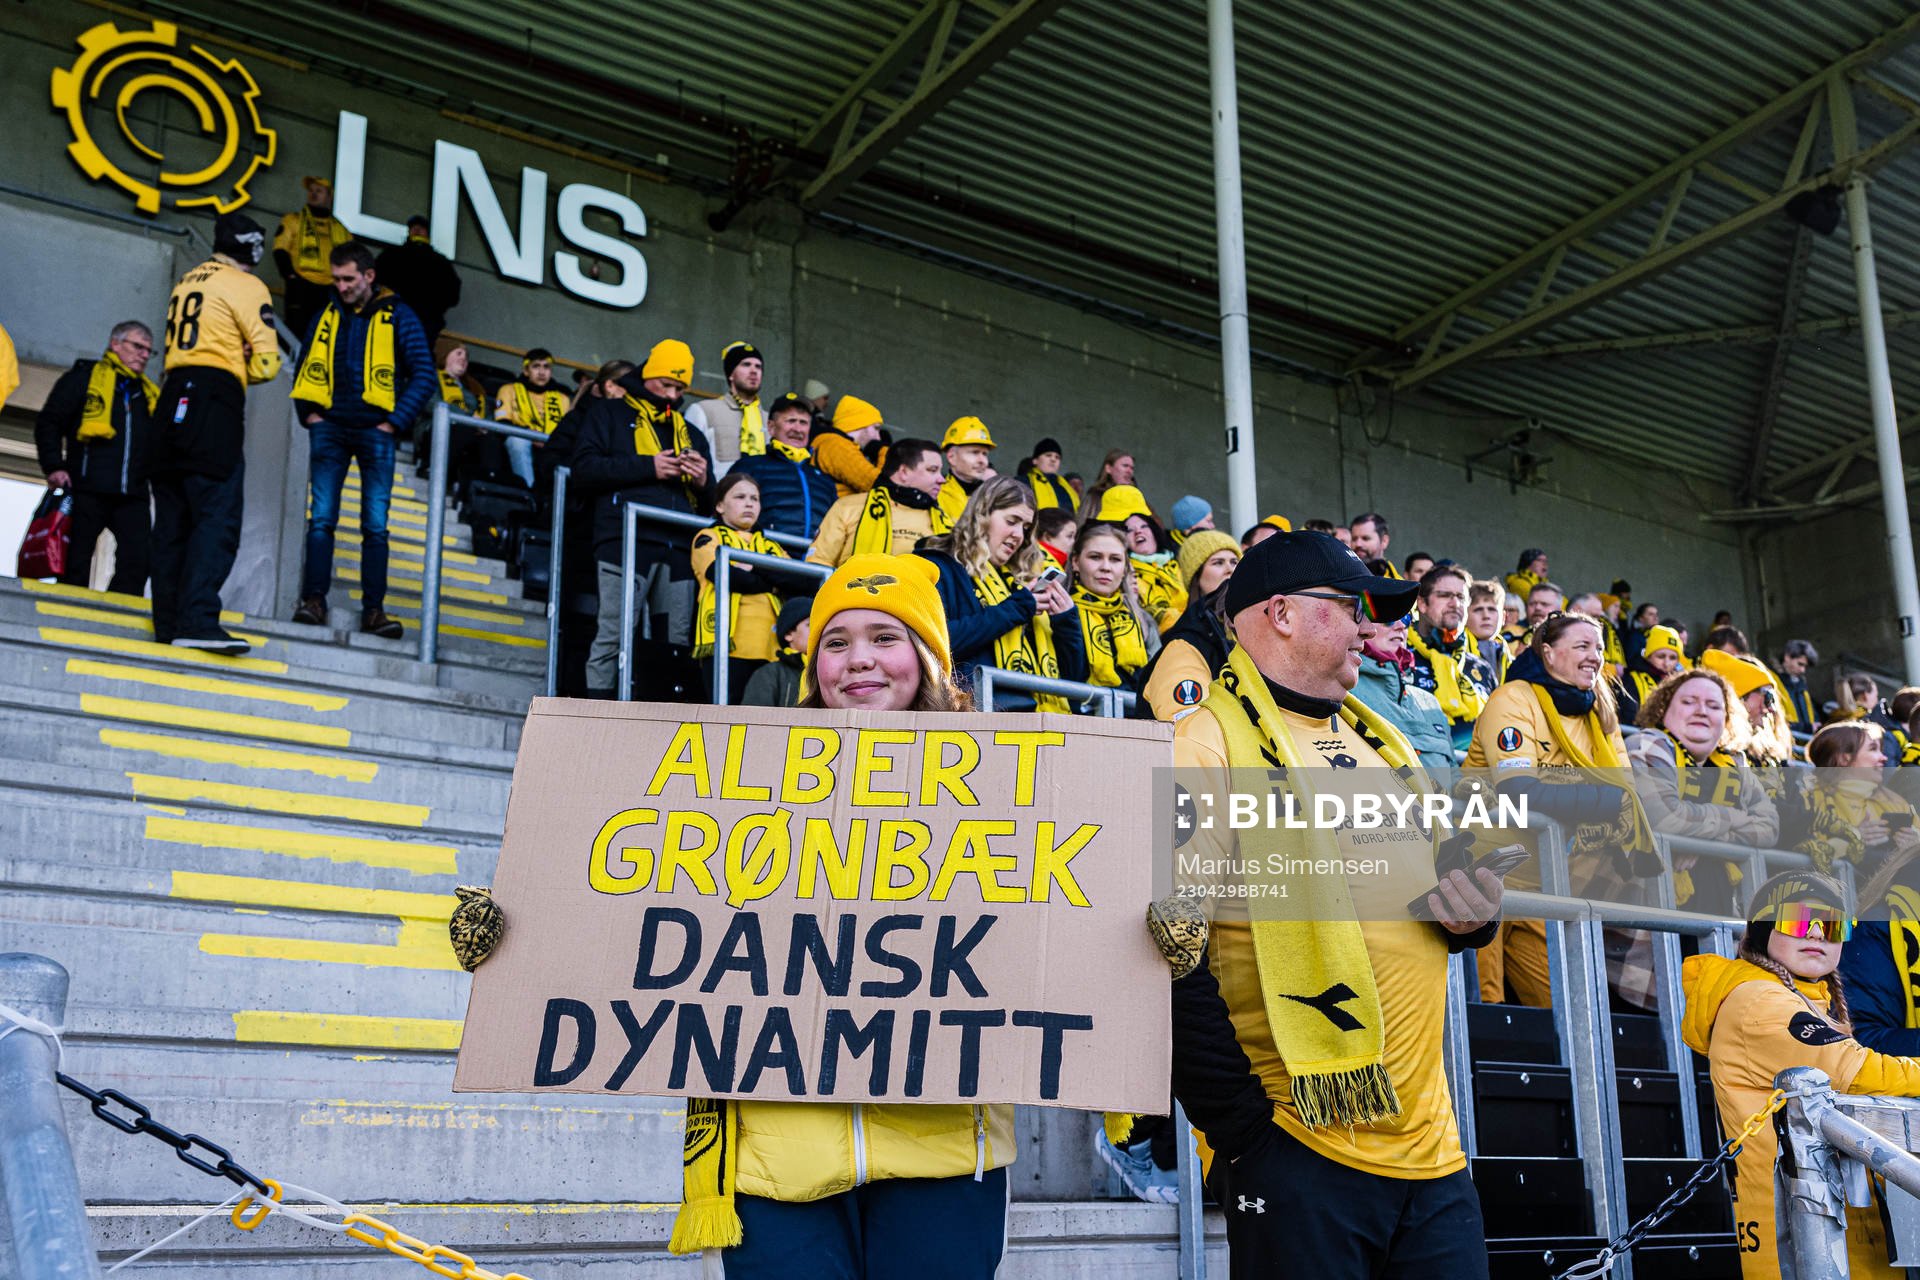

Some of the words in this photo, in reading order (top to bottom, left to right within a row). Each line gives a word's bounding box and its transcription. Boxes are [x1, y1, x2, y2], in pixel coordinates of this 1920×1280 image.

[333, 110, 648, 308] LNS
[645, 722, 1065, 807] ALBERT
[588, 808, 1102, 908] GRØNBÆK
[1352, 831, 1419, 845] NORD-NORGE
[633, 907, 998, 998] DANSK
[533, 997, 1093, 1100] DYNAMITT
